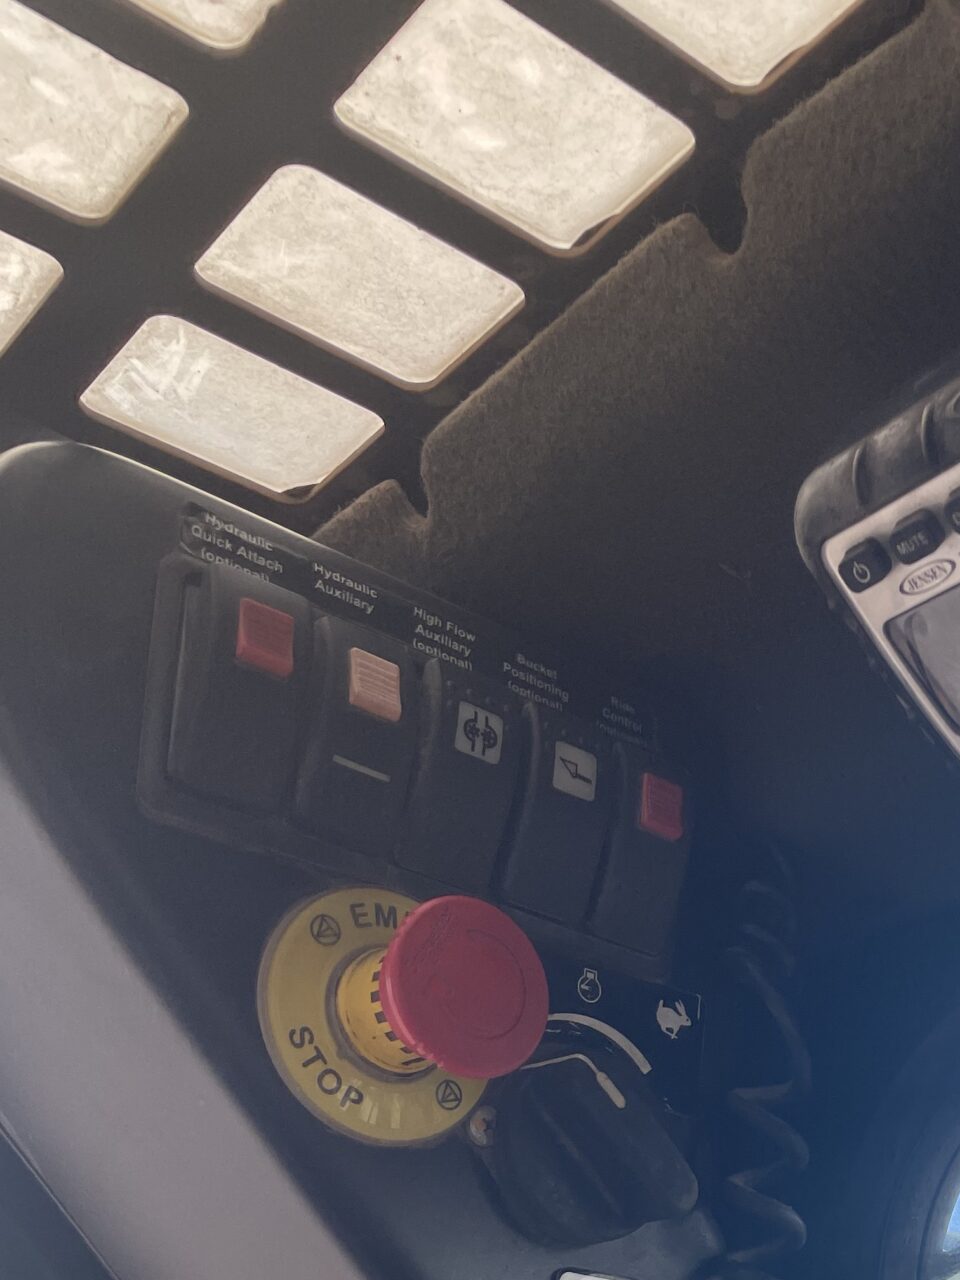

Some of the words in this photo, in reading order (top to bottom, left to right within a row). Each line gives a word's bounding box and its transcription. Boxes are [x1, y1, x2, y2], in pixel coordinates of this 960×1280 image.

[191, 525, 232, 552] Quick
[236, 544, 283, 573] Attach
[204, 513, 273, 550] Hydraulic
[896, 530, 930, 557] MUTE
[314, 560, 378, 598] Hydraulic
[907, 560, 950, 593] JENSEN
[314, 580, 374, 614] Auxiliary
[414, 606, 442, 628] High
[446, 620, 476, 642] Flow
[415, 623, 472, 657] Auxiliary
[412, 638, 473, 671] (optional)
[516, 653, 558, 680] Bucket
[503, 661, 569, 703] Positioning
[288, 1025, 364, 1108] STOP
